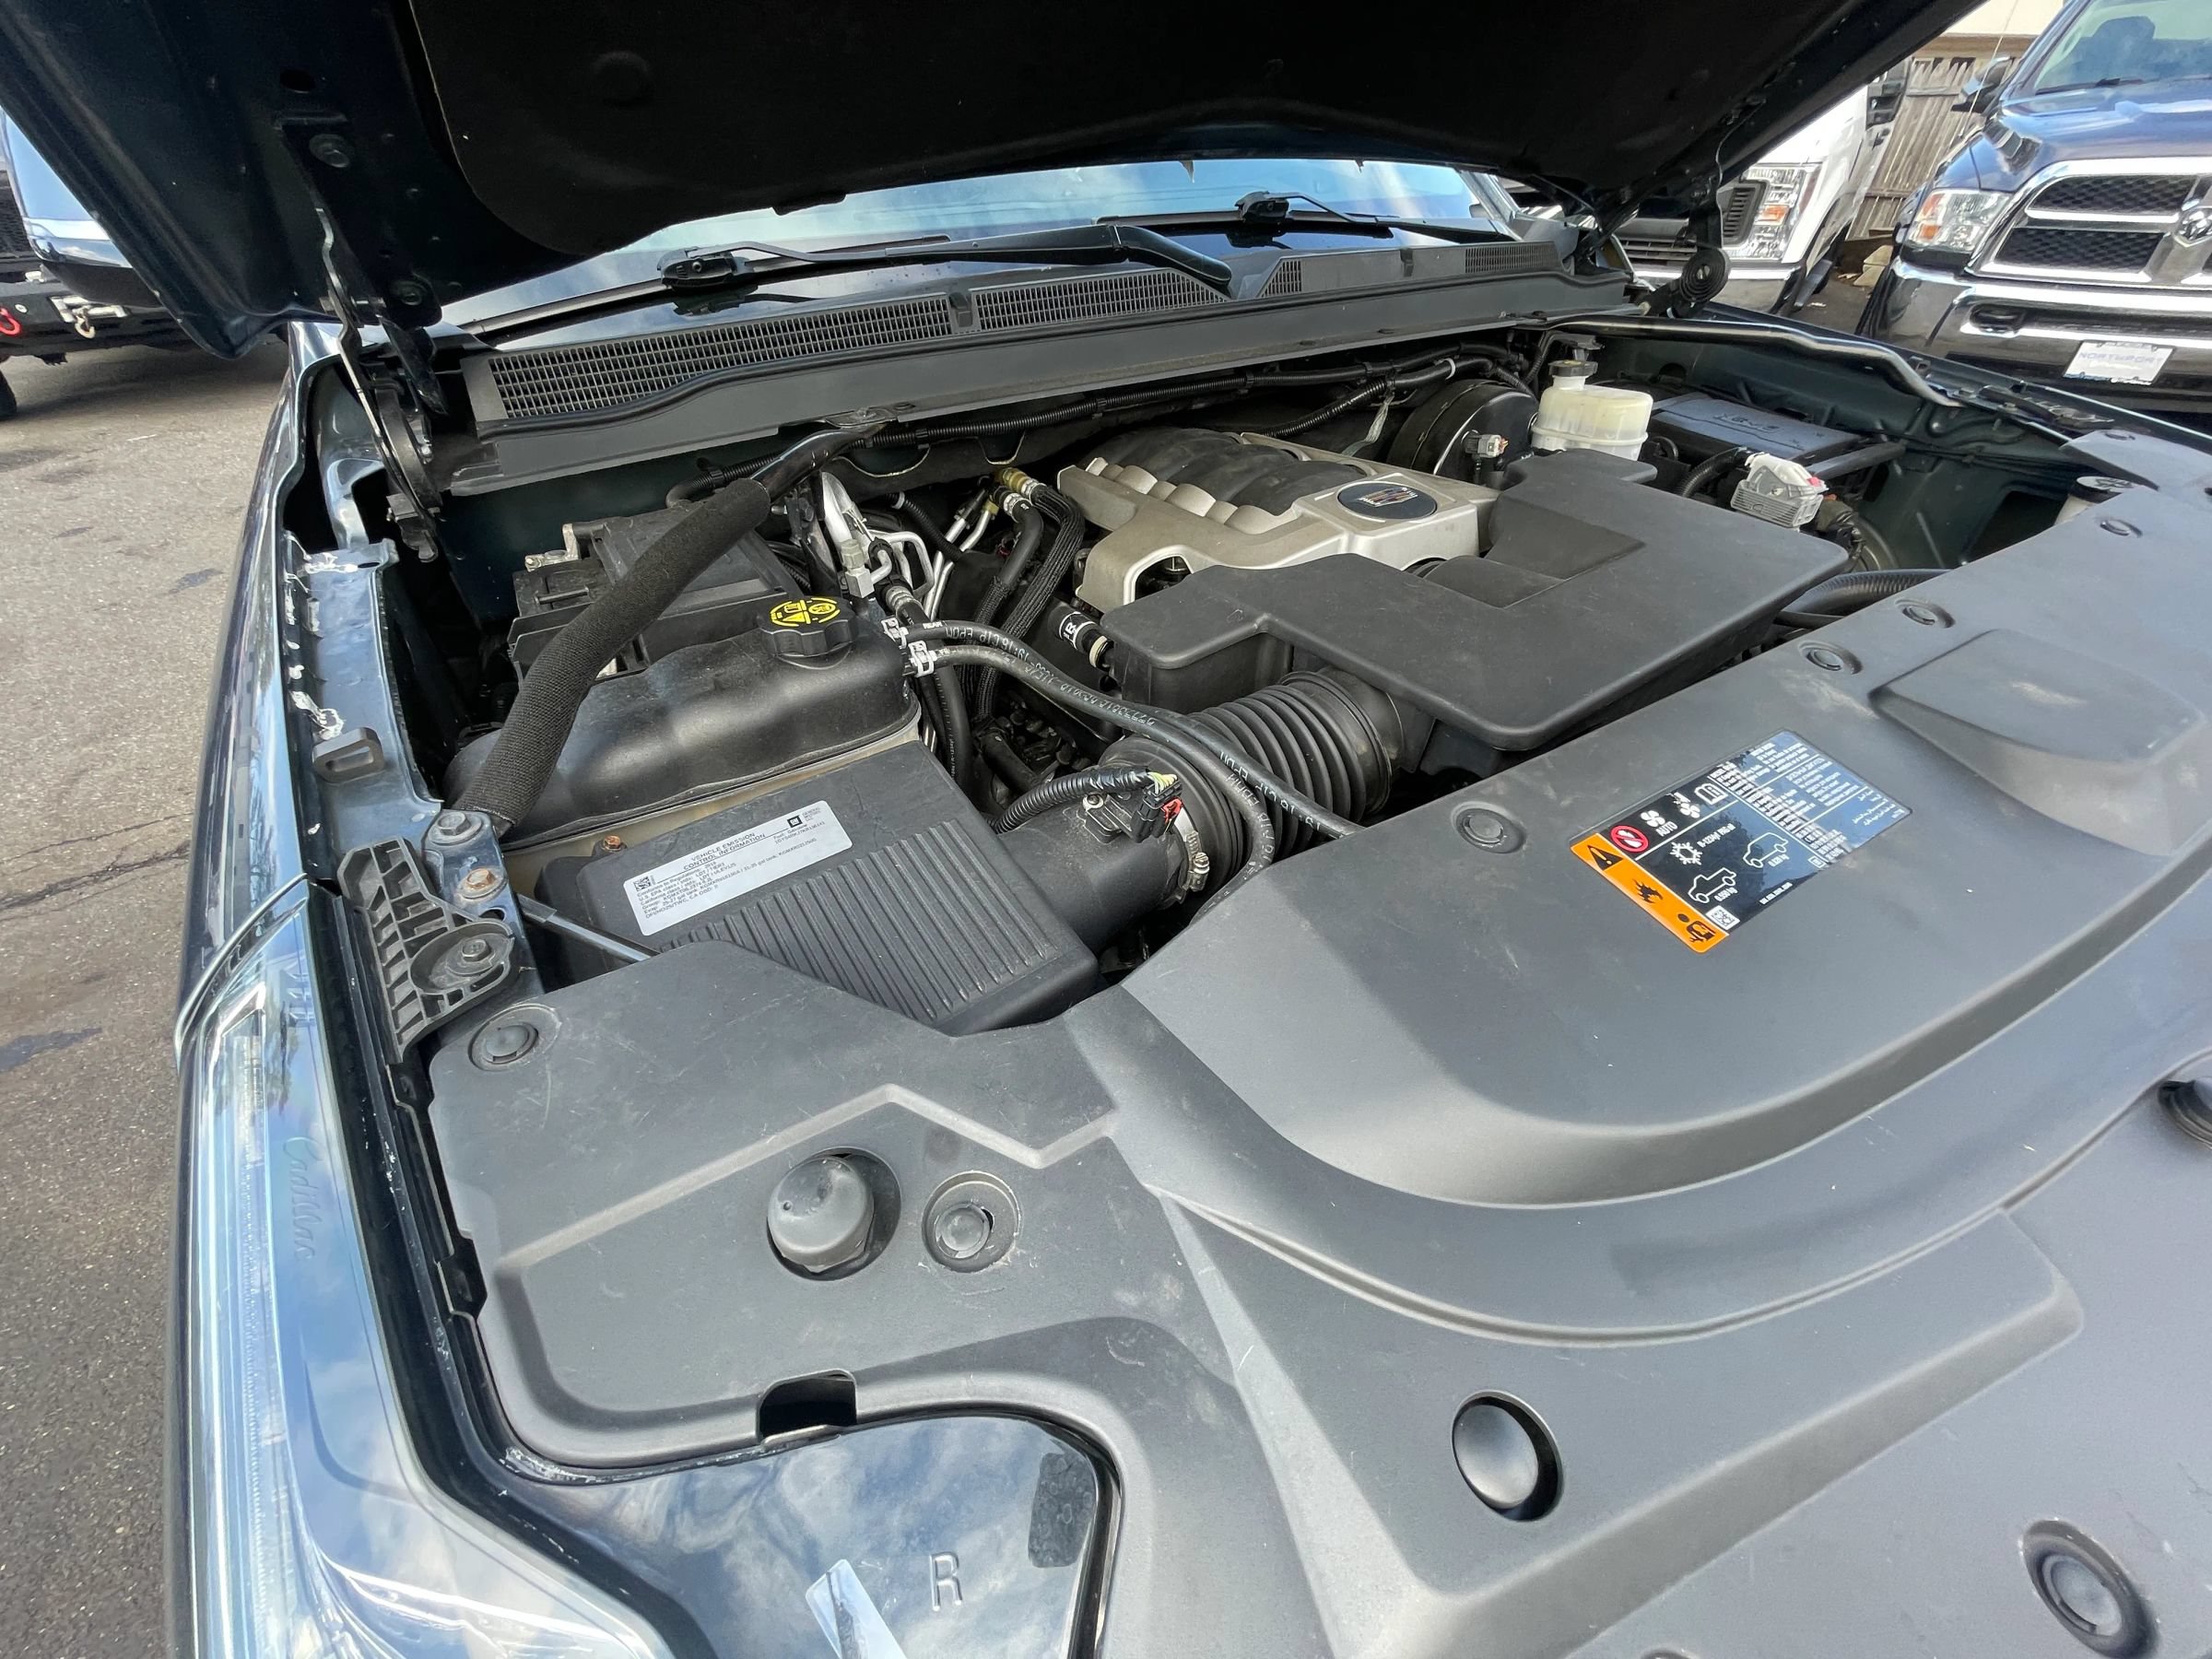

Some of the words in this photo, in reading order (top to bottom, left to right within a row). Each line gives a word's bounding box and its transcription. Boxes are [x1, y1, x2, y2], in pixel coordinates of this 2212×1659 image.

[690, 846, 721, 862] VEHICLE
[721, 831, 756, 849] EMISSION
[1655, 821, 1678, 837] AUTO
[682, 853, 717, 870] CONTROL
[717, 832, 766, 856] INFORMATION
[281, 1135, 324, 1262] Cadillac
[929, 1550, 963, 1612] R
